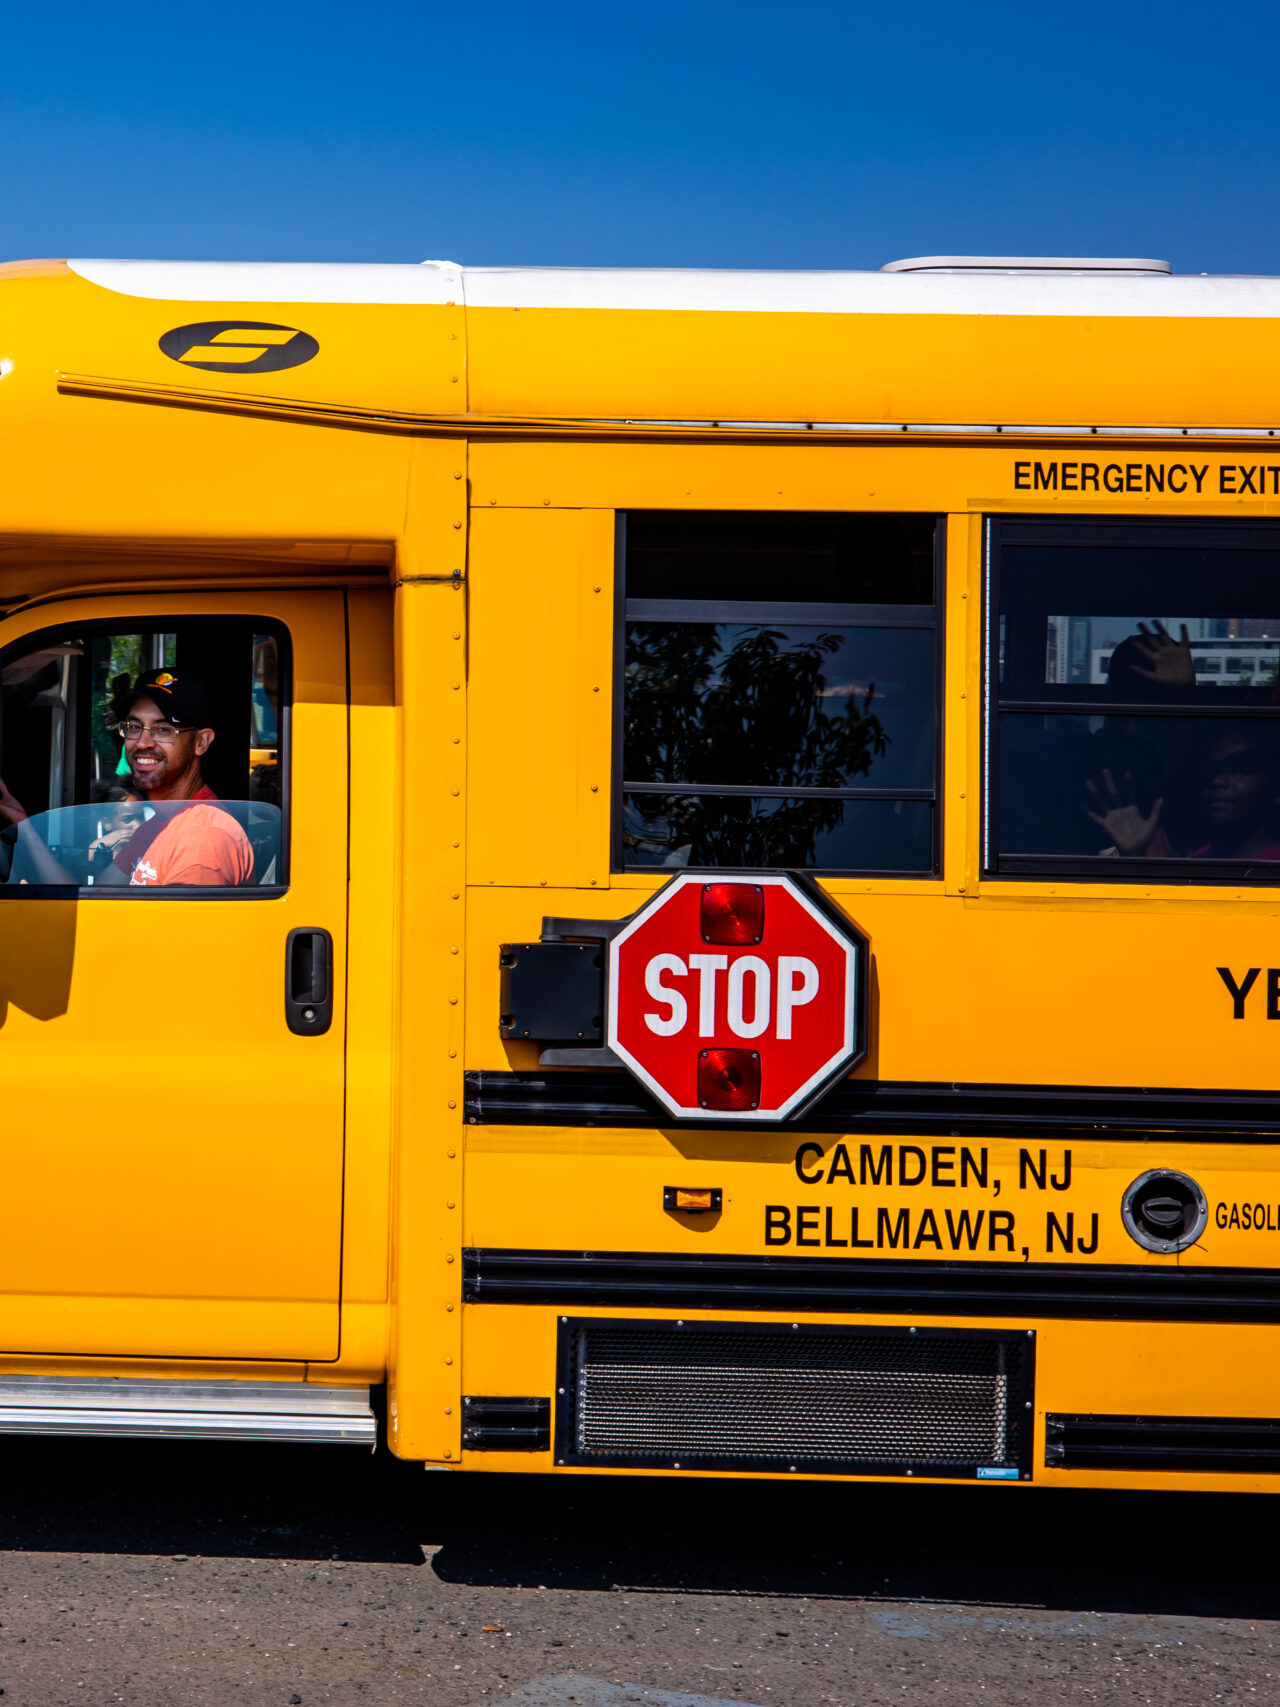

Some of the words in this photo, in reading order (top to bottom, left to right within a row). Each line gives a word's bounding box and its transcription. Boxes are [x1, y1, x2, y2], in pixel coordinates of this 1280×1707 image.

[1014, 461, 1209, 494] EMERGENCY
[1219, 465, 1280, 495] EXIT
[644, 952, 820, 1040] STOP
[794, 1141, 1001, 1197] CAMDEN,
[1019, 1148, 1072, 1191] NJ
[764, 1205, 1029, 1262] BELLMAWR,
[1046, 1211, 1099, 1255] NJ
